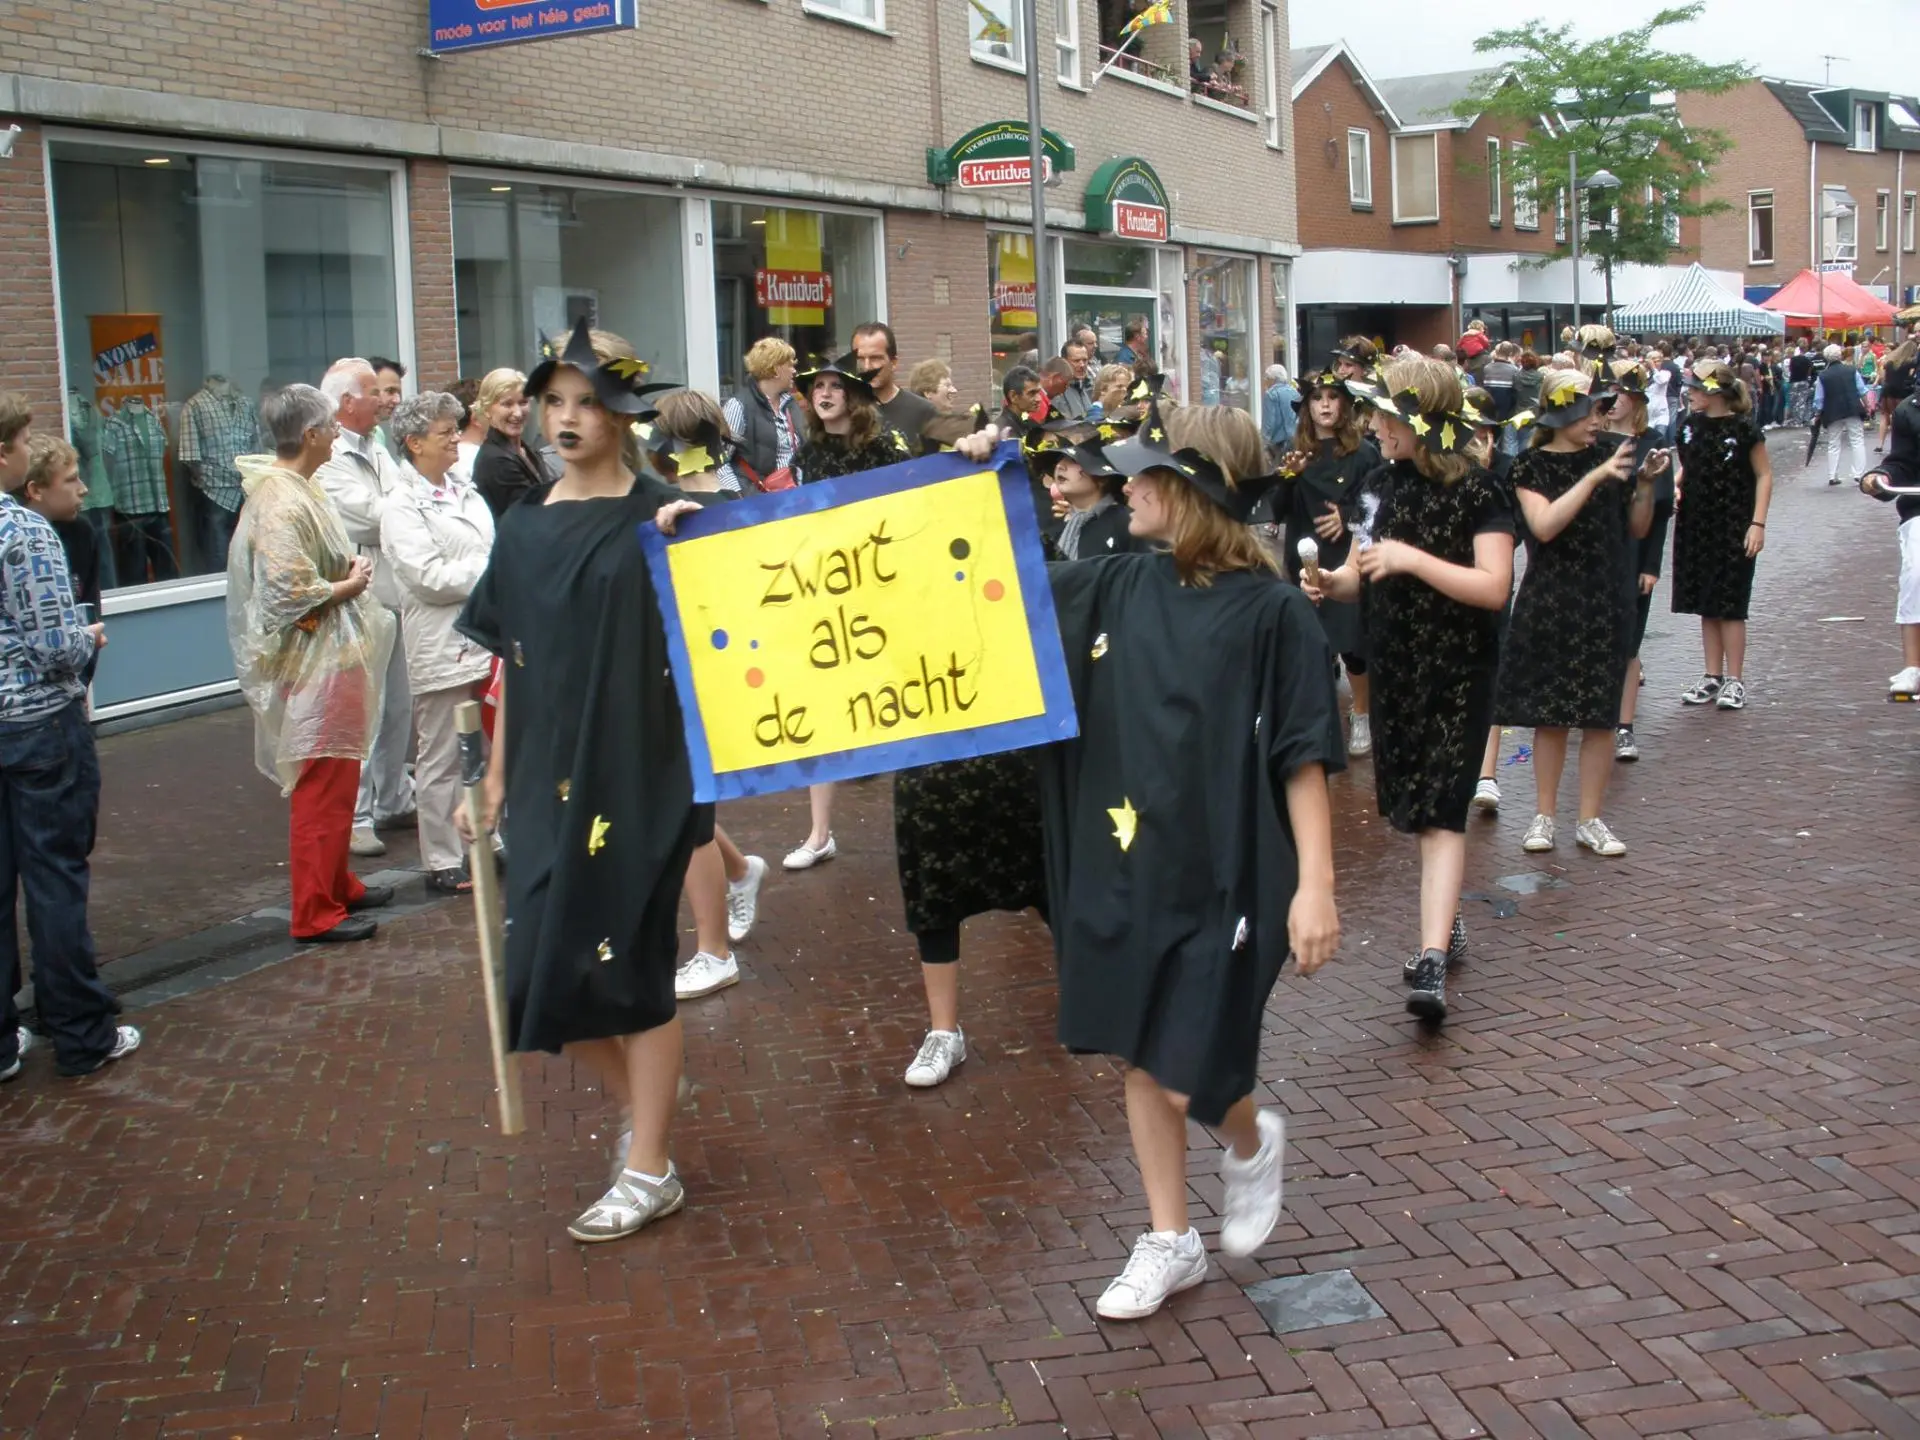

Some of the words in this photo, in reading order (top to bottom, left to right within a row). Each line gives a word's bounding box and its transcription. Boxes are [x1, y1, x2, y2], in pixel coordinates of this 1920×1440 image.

[435, 23, 473, 41] mode
[477, 17, 507, 35] voor
[511, 12, 534, 30] het
[574, 2, 611, 24] gezin
[972, 163, 1032, 182] Kruidva
[1126, 208, 1157, 233] Kruidvat
[766, 273, 825, 303] Kruidvat
[1000, 285, 1036, 308] Kruidva
[758, 520, 898, 606] zwart
[809, 604, 888, 669] als
[754, 693, 815, 747] de
[847, 651, 978, 733] nacht
